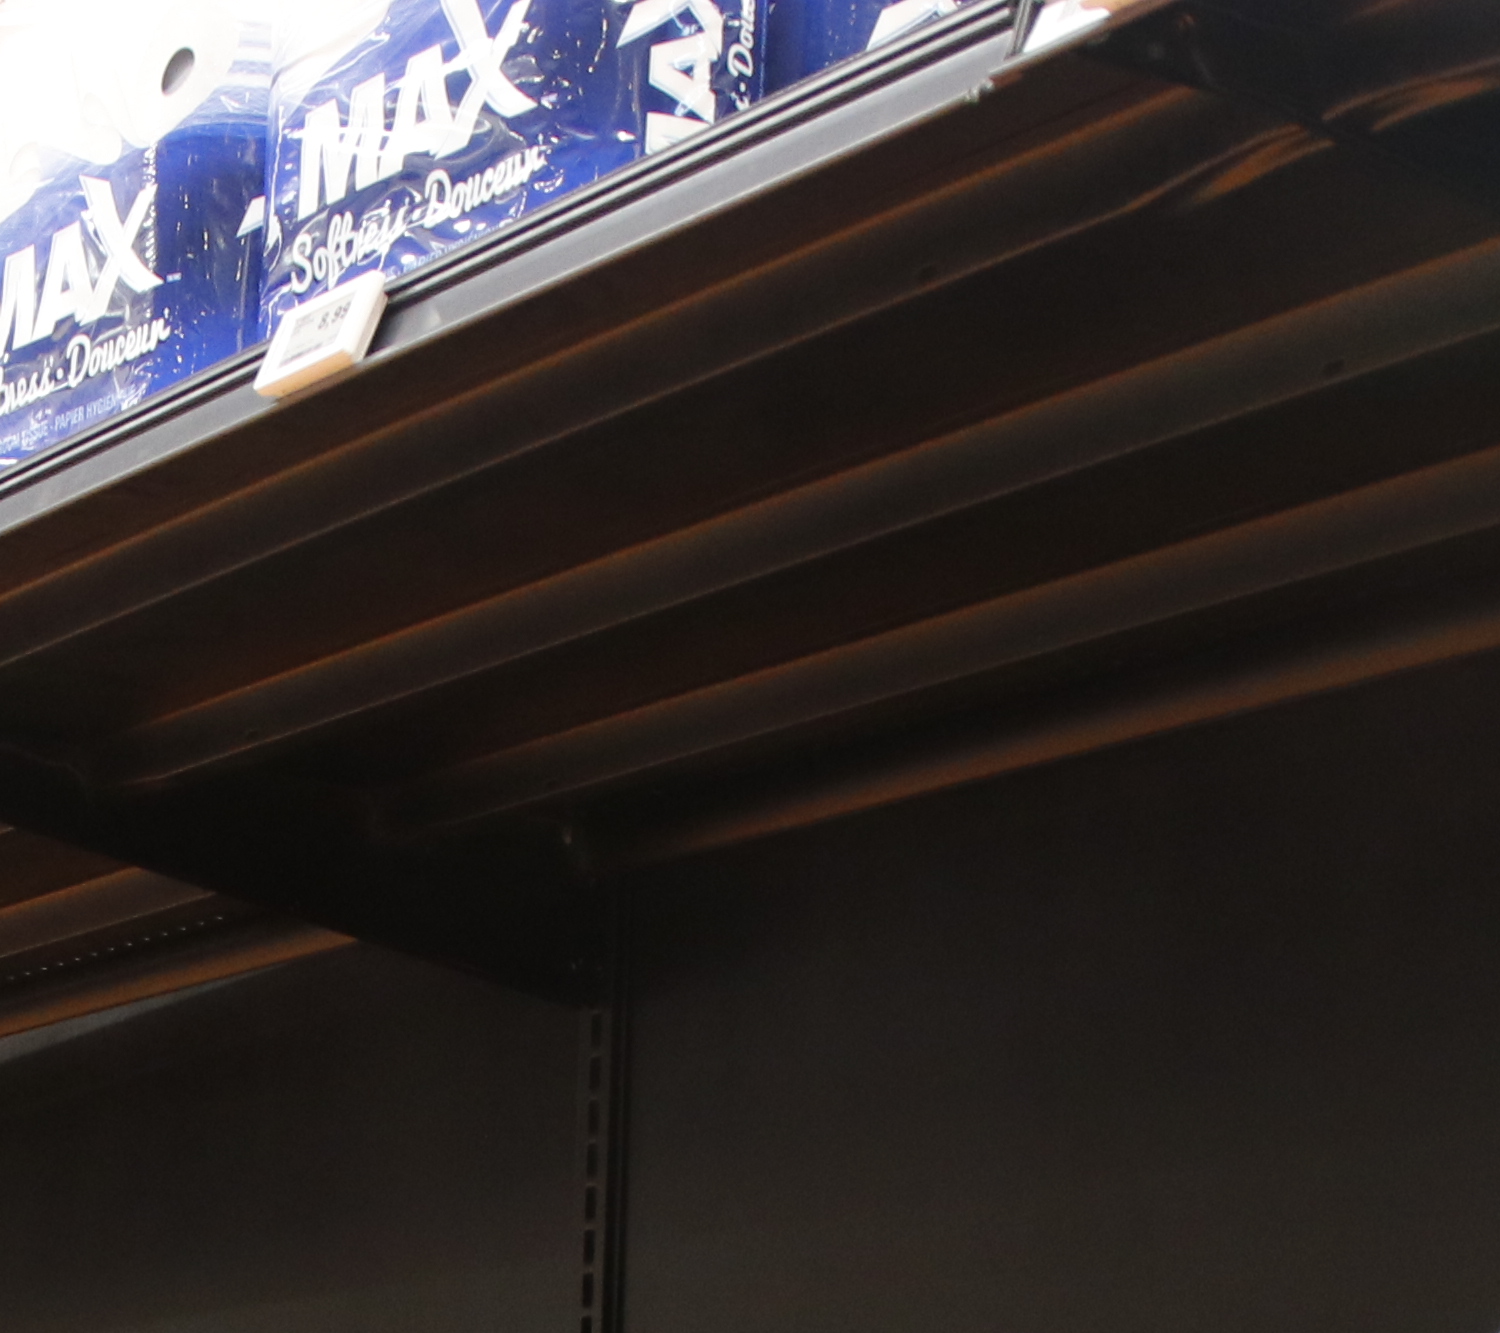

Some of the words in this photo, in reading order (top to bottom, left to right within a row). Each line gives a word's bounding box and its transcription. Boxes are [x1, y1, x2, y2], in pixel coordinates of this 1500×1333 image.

[297, 0, 538, 221] MAX
[291, 208, 404, 293] Softness
[424, 147, 547, 229] Douceur
[67, 317, 170, 388] Douceur
